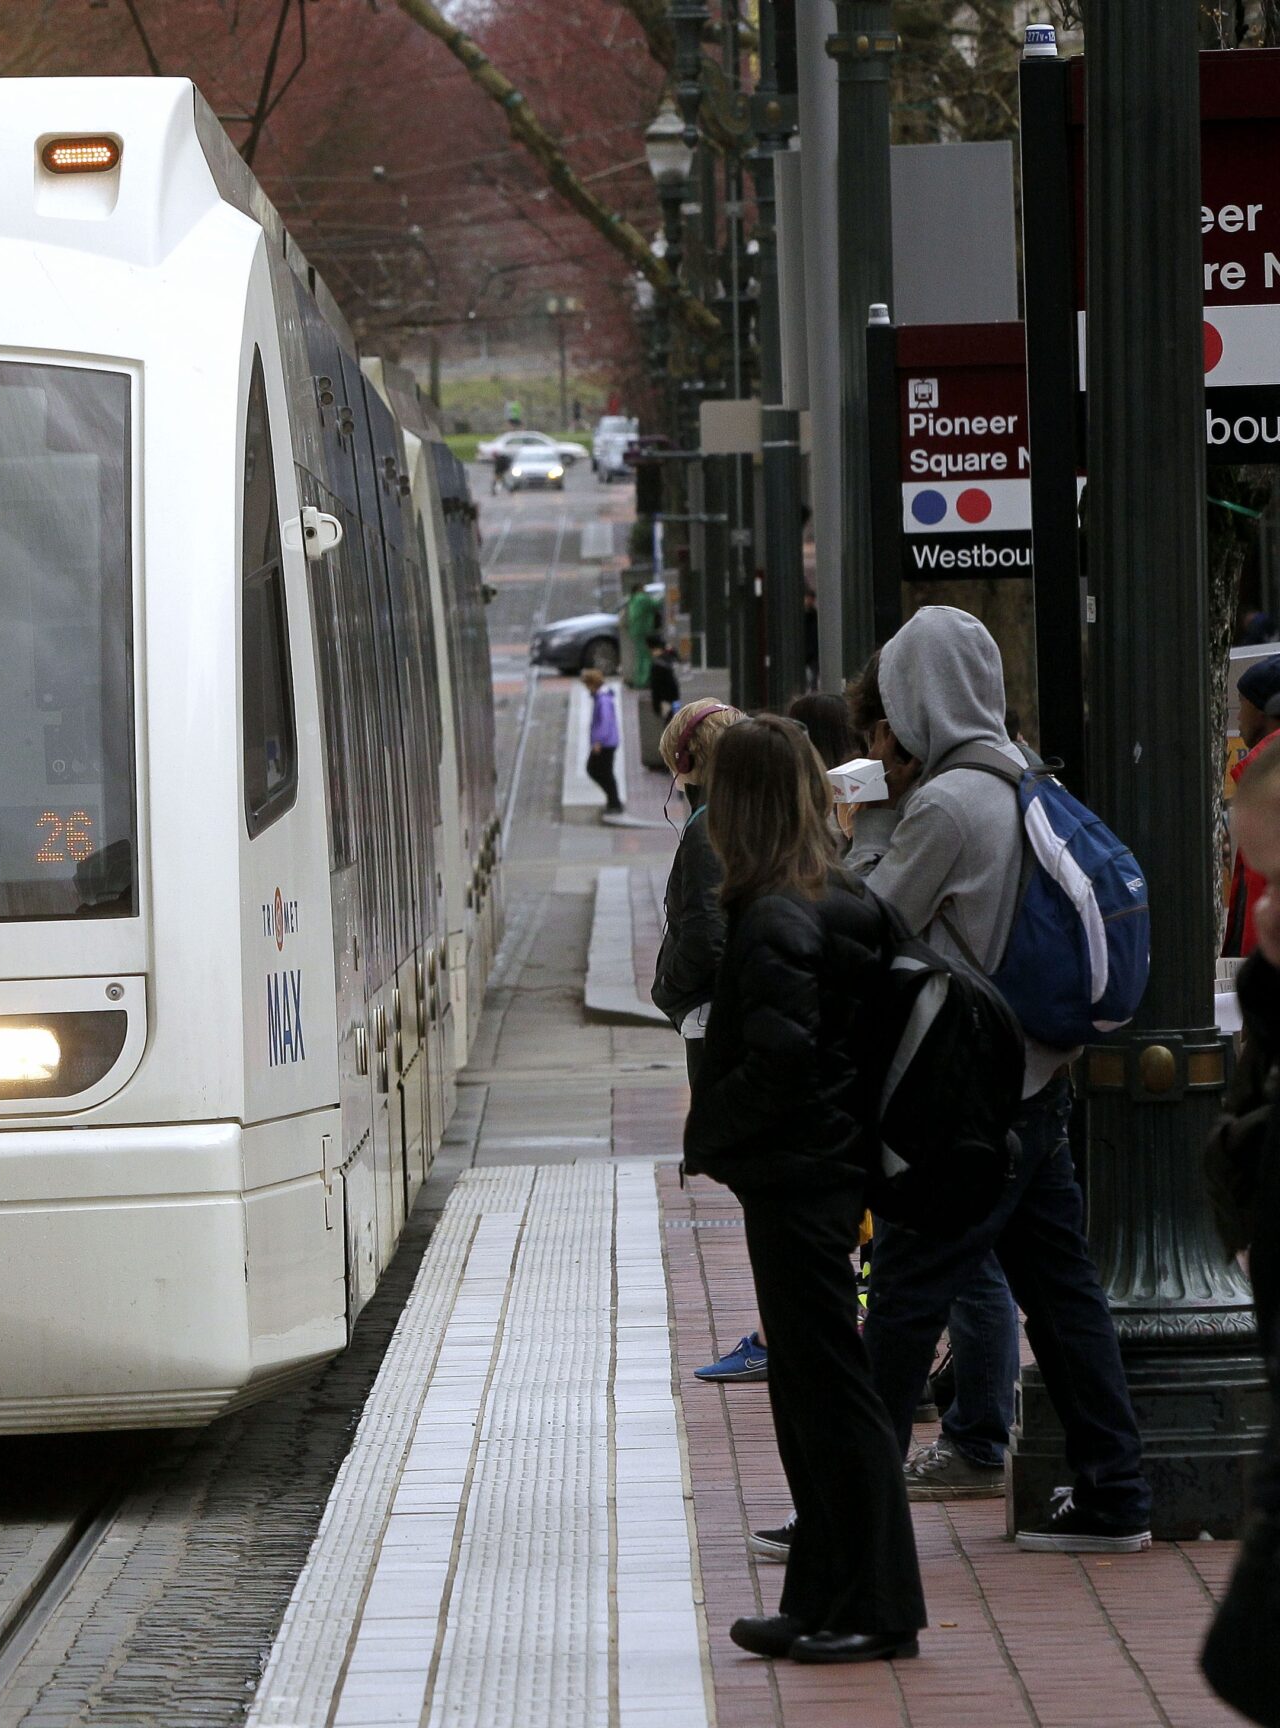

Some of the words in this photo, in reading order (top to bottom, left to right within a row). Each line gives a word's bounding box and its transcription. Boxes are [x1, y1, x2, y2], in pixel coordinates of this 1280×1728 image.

[909, 413, 1018, 436] Pioneer
[910, 449, 1008, 478] Square
[912, 543, 1033, 568] Westbou
[36, 811, 93, 862] 26
[267, 969, 305, 1068] MAX
